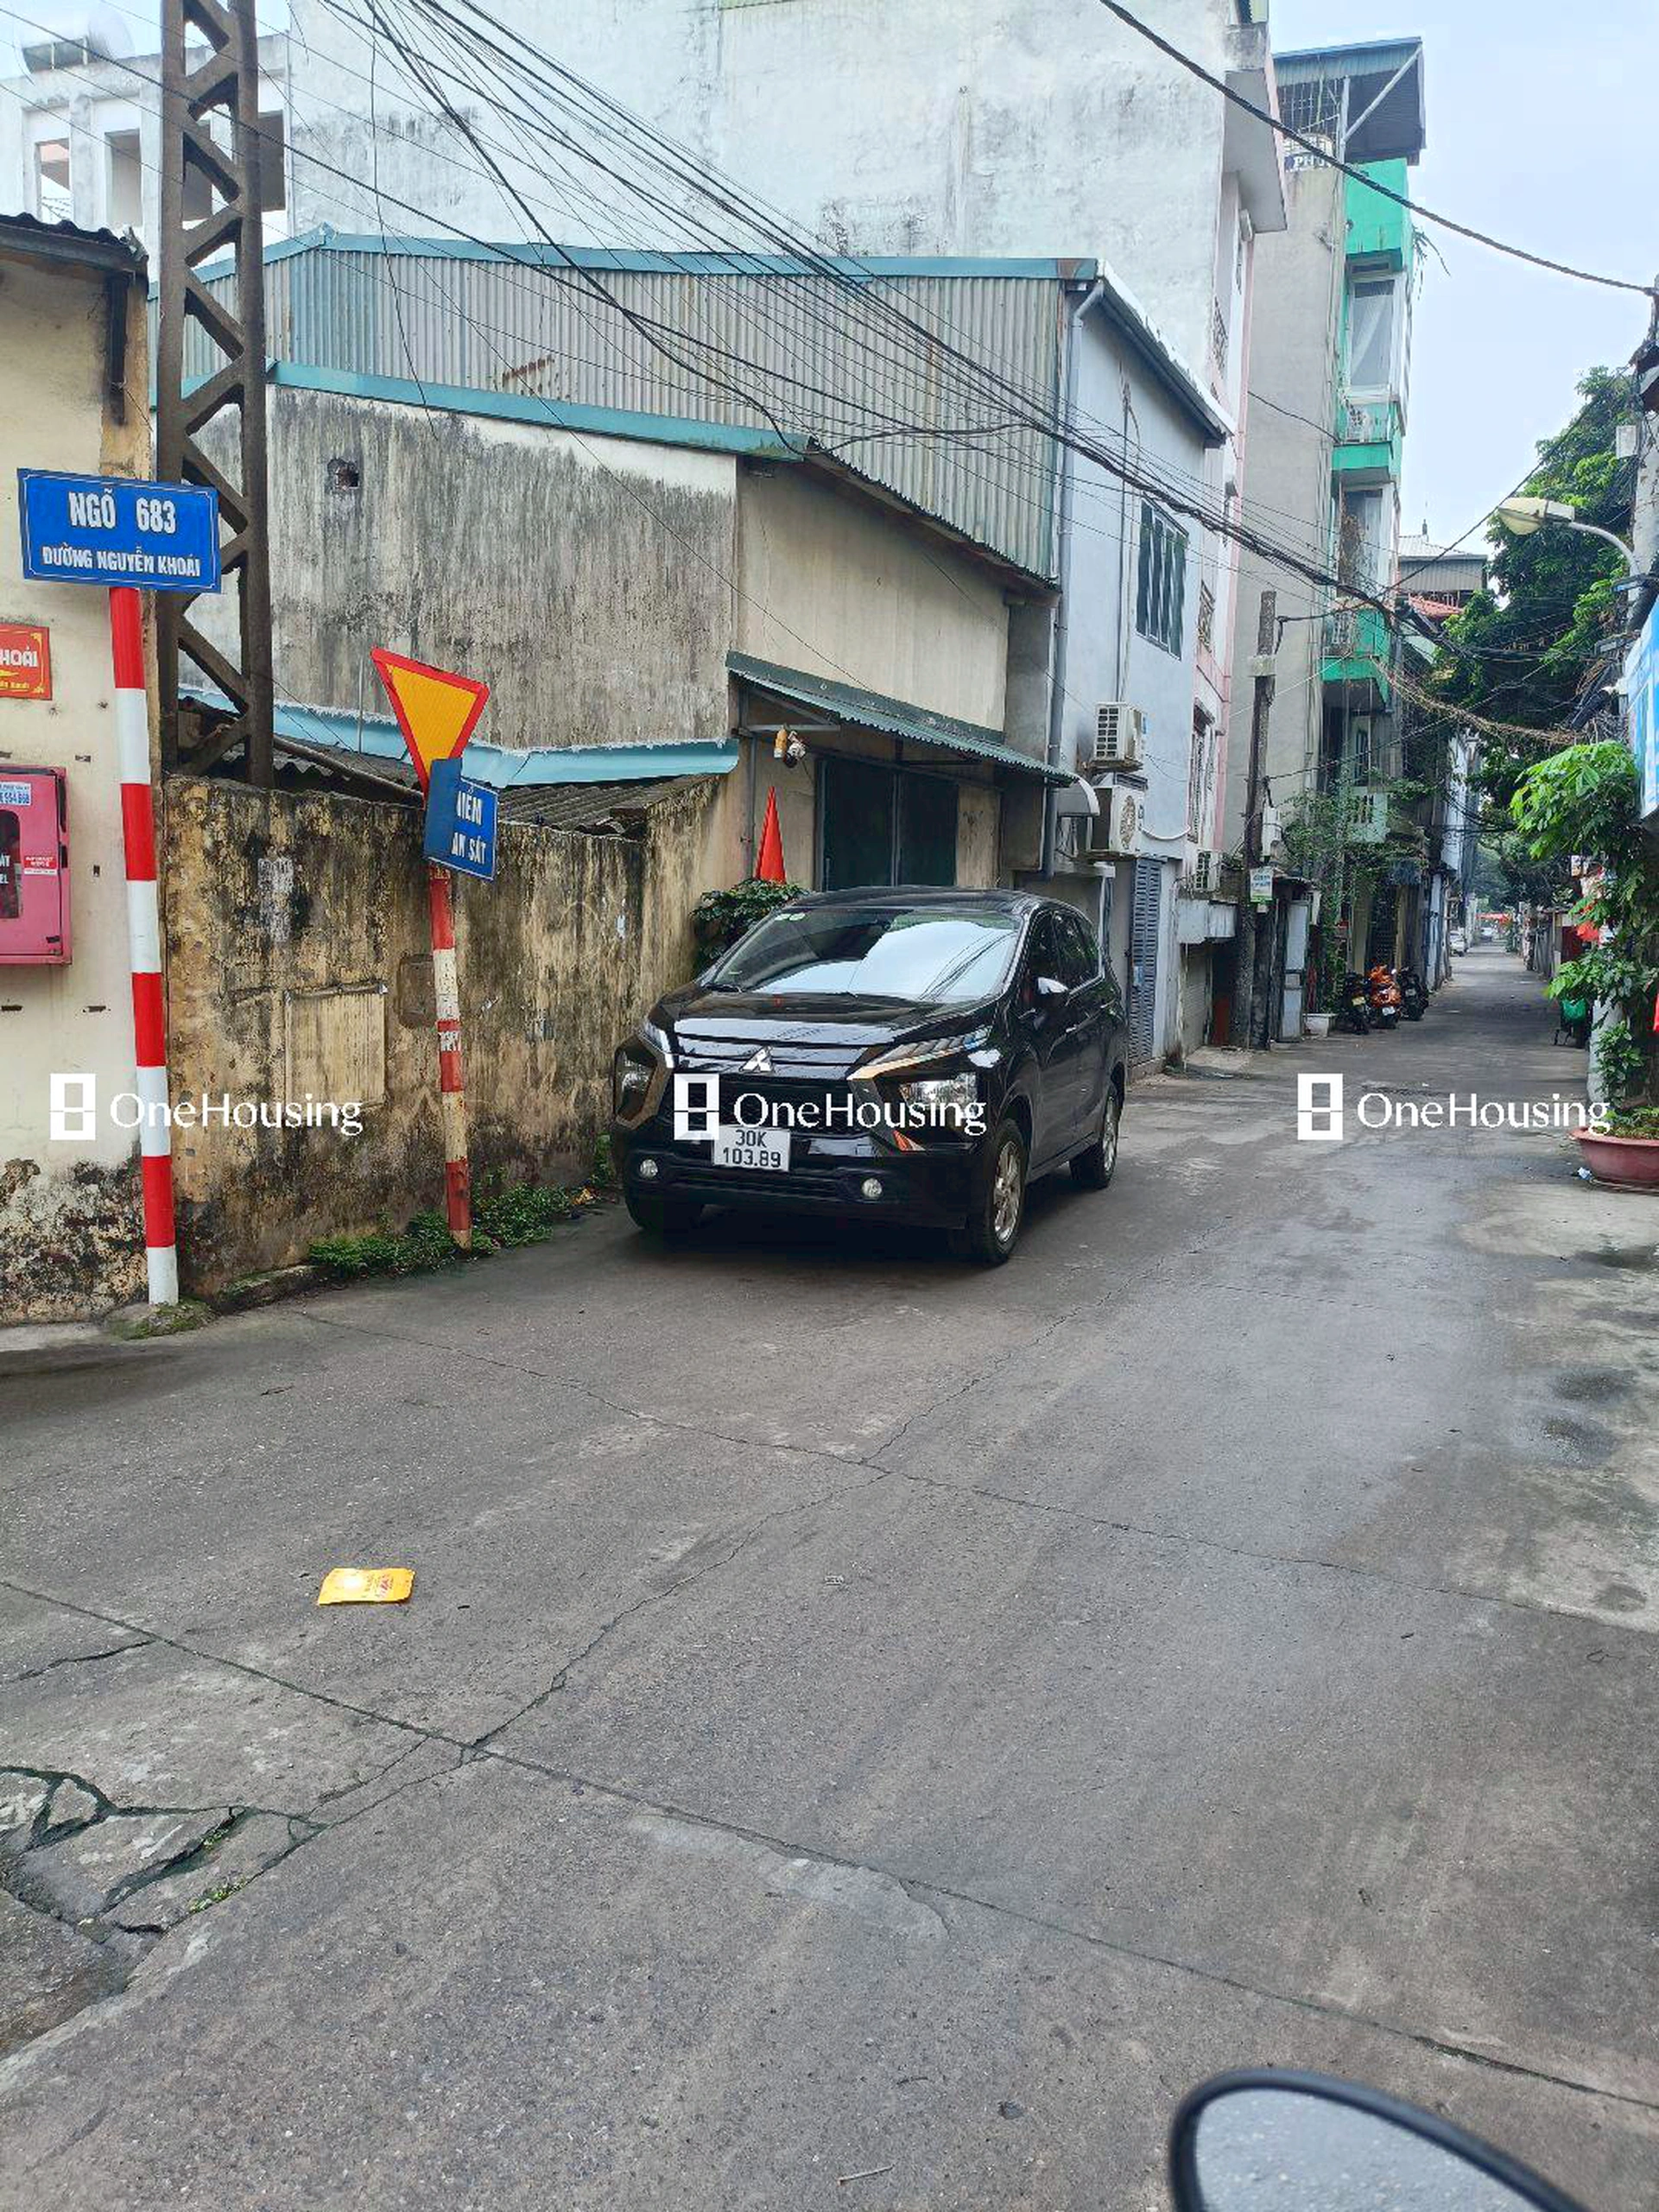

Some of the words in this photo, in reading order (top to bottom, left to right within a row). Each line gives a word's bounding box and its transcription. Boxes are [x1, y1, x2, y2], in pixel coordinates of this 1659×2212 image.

[68, 489, 116, 529] NGÕ
[136, 497, 176, 534] 683
[42, 542, 93, 569] ĐƯỜNG
[97, 546, 155, 574] NGUYỄN
[157, 554, 201, 577] KHOÁI
[0, 645, 39, 668] HOÁI
[735, 1129, 768, 1148] 30K
[723, 1147, 782, 1168] 103.89
